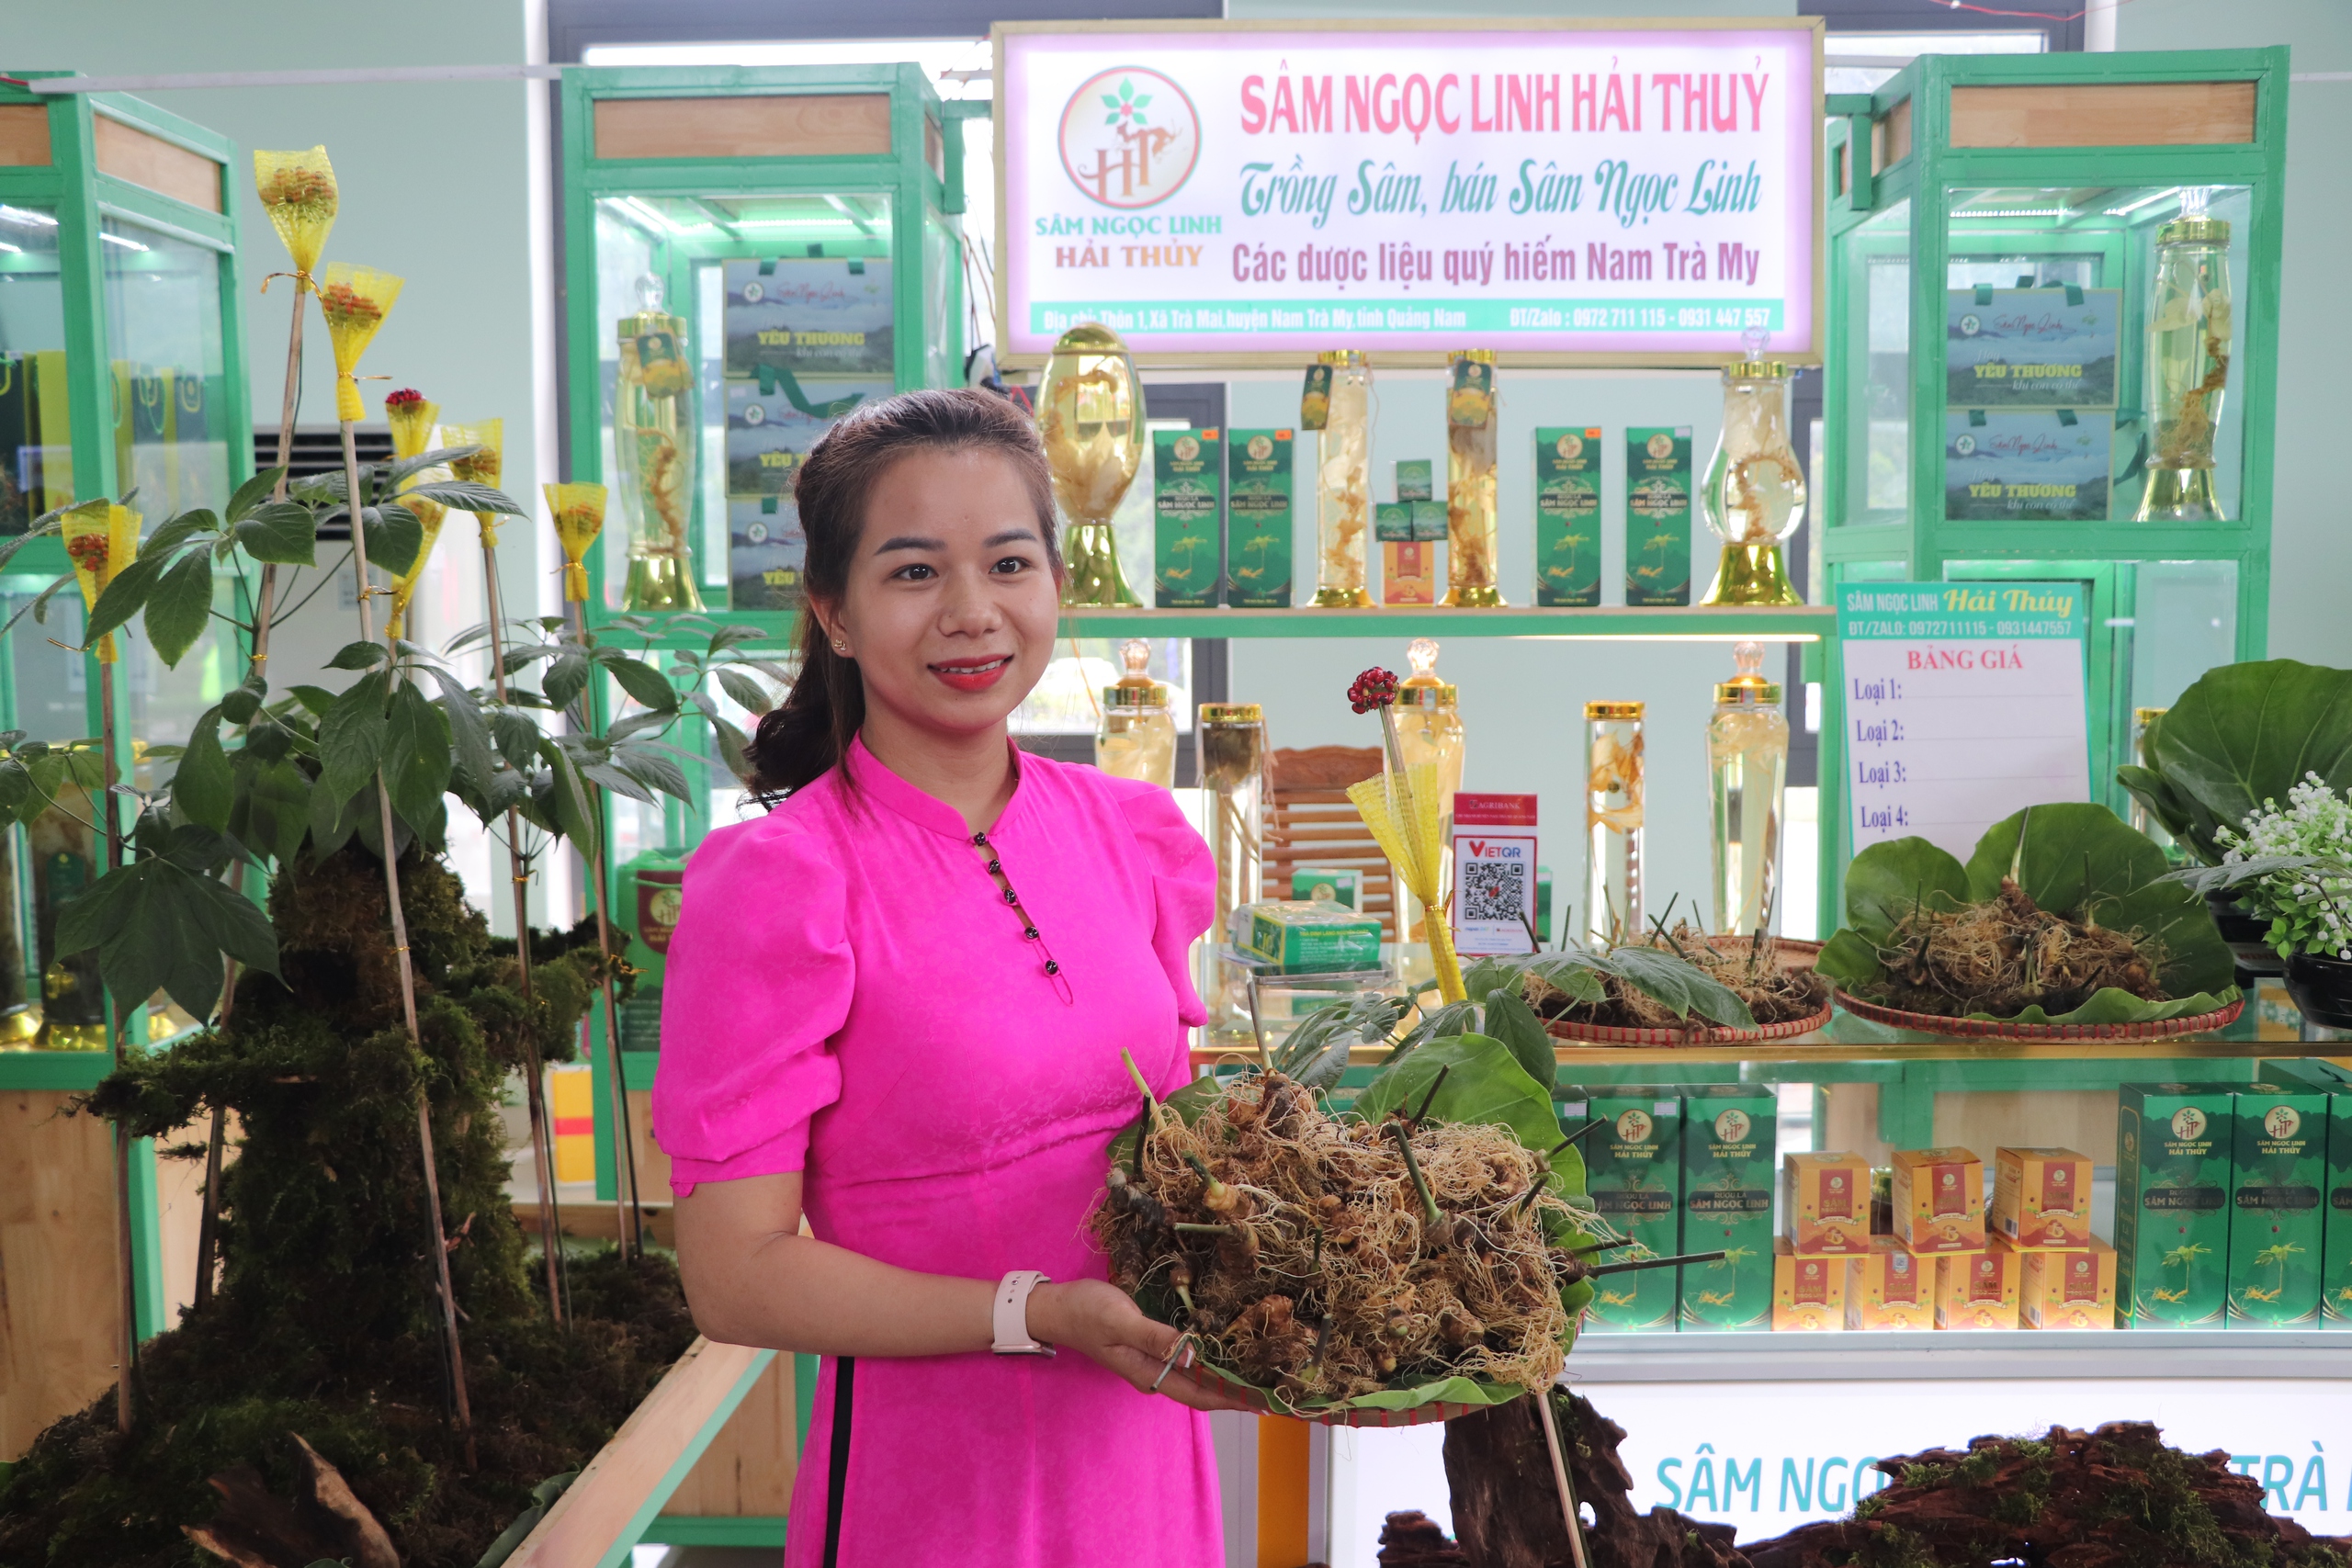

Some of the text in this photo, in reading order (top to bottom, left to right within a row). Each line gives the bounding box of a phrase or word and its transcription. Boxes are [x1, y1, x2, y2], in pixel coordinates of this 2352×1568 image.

[1240, 58, 1333, 134] SÂM
[1345, 73, 1461, 145] NGỌC
[1471, 73, 1561, 132] LINH
[1572, 55, 1642, 132] HẢI
[1239, 153, 1763, 230] Trồng Sâm, bán Sâm Ngọc Linh
[1035, 214, 1223, 239] SÂM NGỌC LINH
[1056, 238, 1204, 268] HẢI THỦY
[1232, 234, 1760, 291] Các dược liệu quý hiếm Nam Trà My
[1044, 310, 1068, 333] Địa
[1171, 309, 1193, 329] Trà
[1272, 309, 1304, 328] Nam
[1306, 308, 1329, 328] Trà
[1387, 306, 1430, 330] Quảng
[1433, 308, 1466, 328] Nam
[1573, 308, 1607, 327] 0972
[1611, 308, 1635, 327] 711
[1640, 308, 1665, 327] 115
[1679, 308, 1710, 327] 0931
[1715, 308, 1741, 327] 447
[1745, 308, 1770, 327] 557
[757, 329, 790, 345] YÊU
[1973, 362, 2007, 378] YÊU
[760, 452, 792, 468] YÊU
[1968, 481, 2002, 498] YÊU
[763, 570, 795, 585] YÊU
[1847, 591, 1874, 612] SÂM
[1877, 593, 1908, 615] NGỌC
[1911, 593, 1939, 611] LINH
[1849, 620, 2072, 636] ĐT/ZALO: 0972711115 0931447557
[1906, 644, 2023, 670] BẢNG GIÁ
[1854, 678, 1902, 705] Loại 1:
[1856, 719, 1905, 747] Loại 2:
[1859, 761, 1906, 789] Loại 3:
[1860, 805, 1909, 833] Loại 4:
[1614, 1201, 1645, 1211] NGỌC
[1648, 1201, 1671, 1209] LINH
[1690, 1198, 1769, 1210] SÂM NGỌC LINH
[2144, 1195, 2165, 1206] SÂM
[2236, 1195, 2258, 1205] SÂM
[1655, 1443, 1762, 1512] SÂM
[2231, 1440, 2328, 1512] TRÀ
